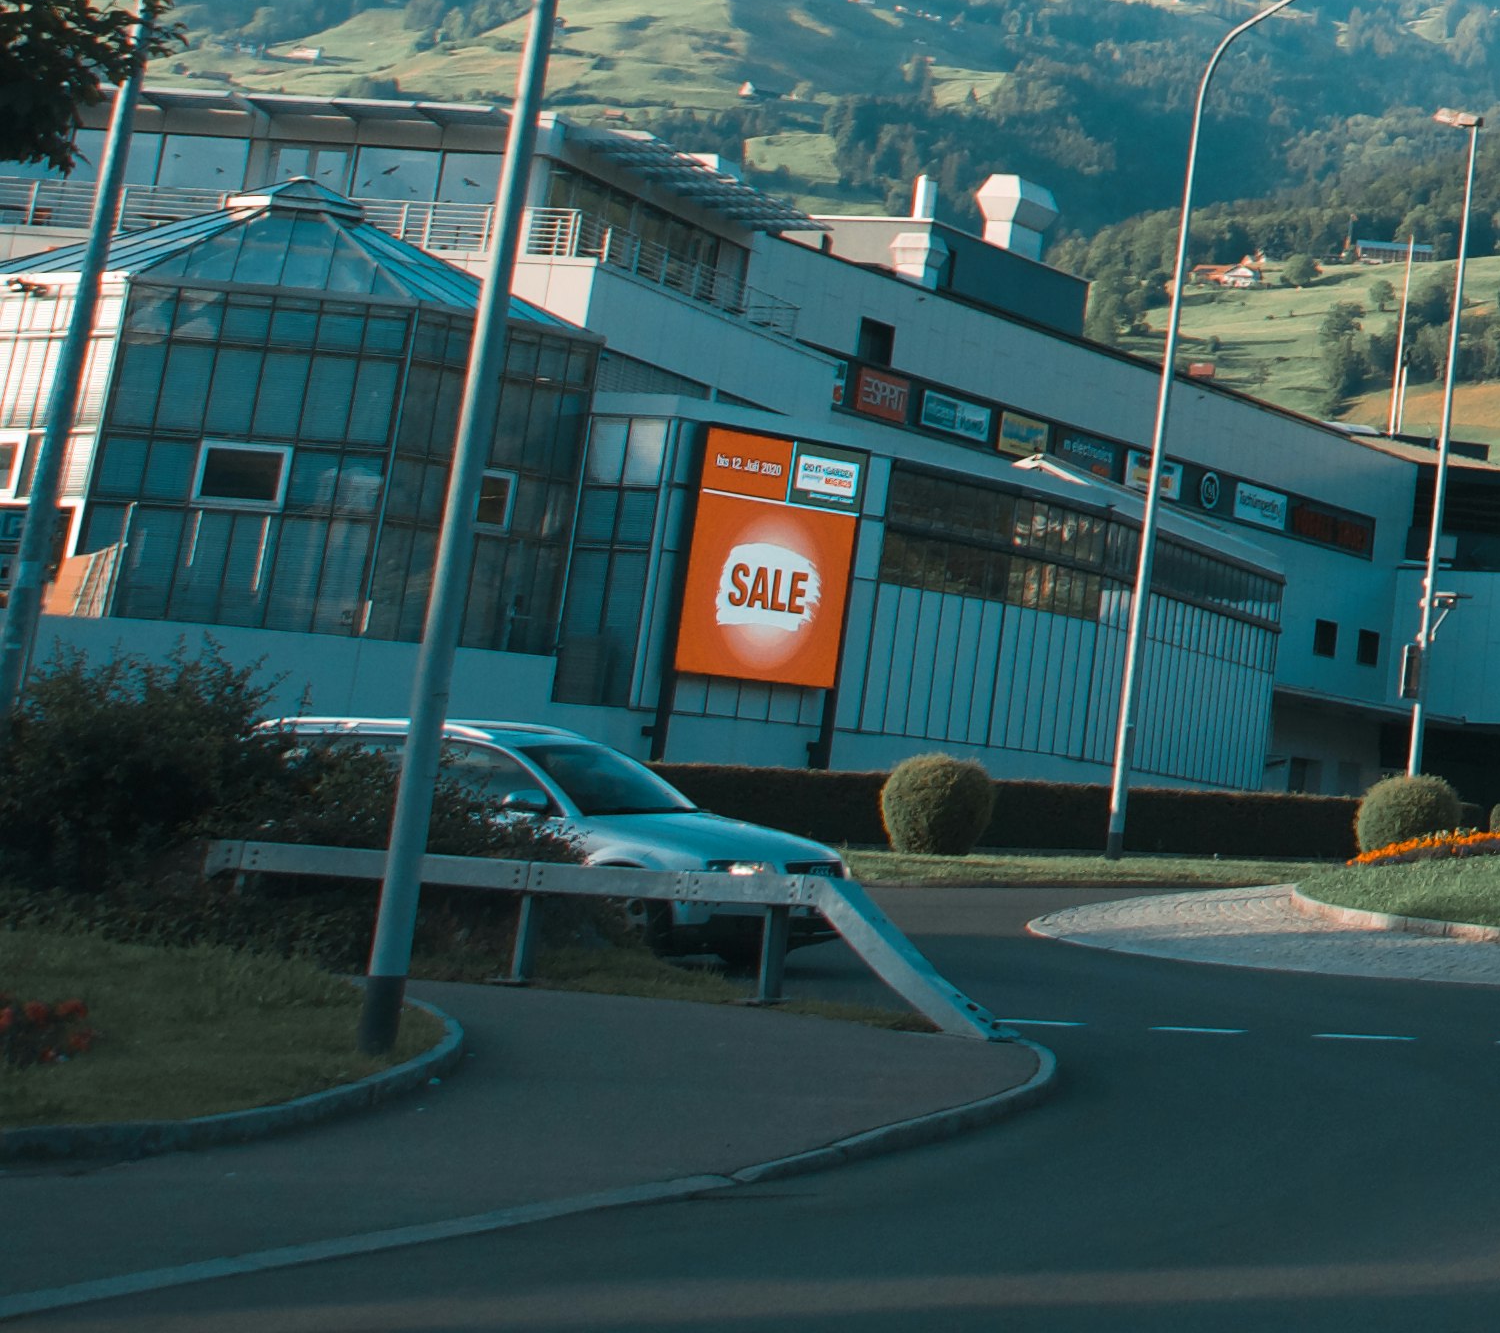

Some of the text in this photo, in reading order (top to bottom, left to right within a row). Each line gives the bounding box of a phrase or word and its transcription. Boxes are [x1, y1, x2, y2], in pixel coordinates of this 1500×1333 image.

[863, 377, 907, 411] ESPRIT
[761, 462, 782, 476] 2020
[728, 562, 809, 615] SALE
